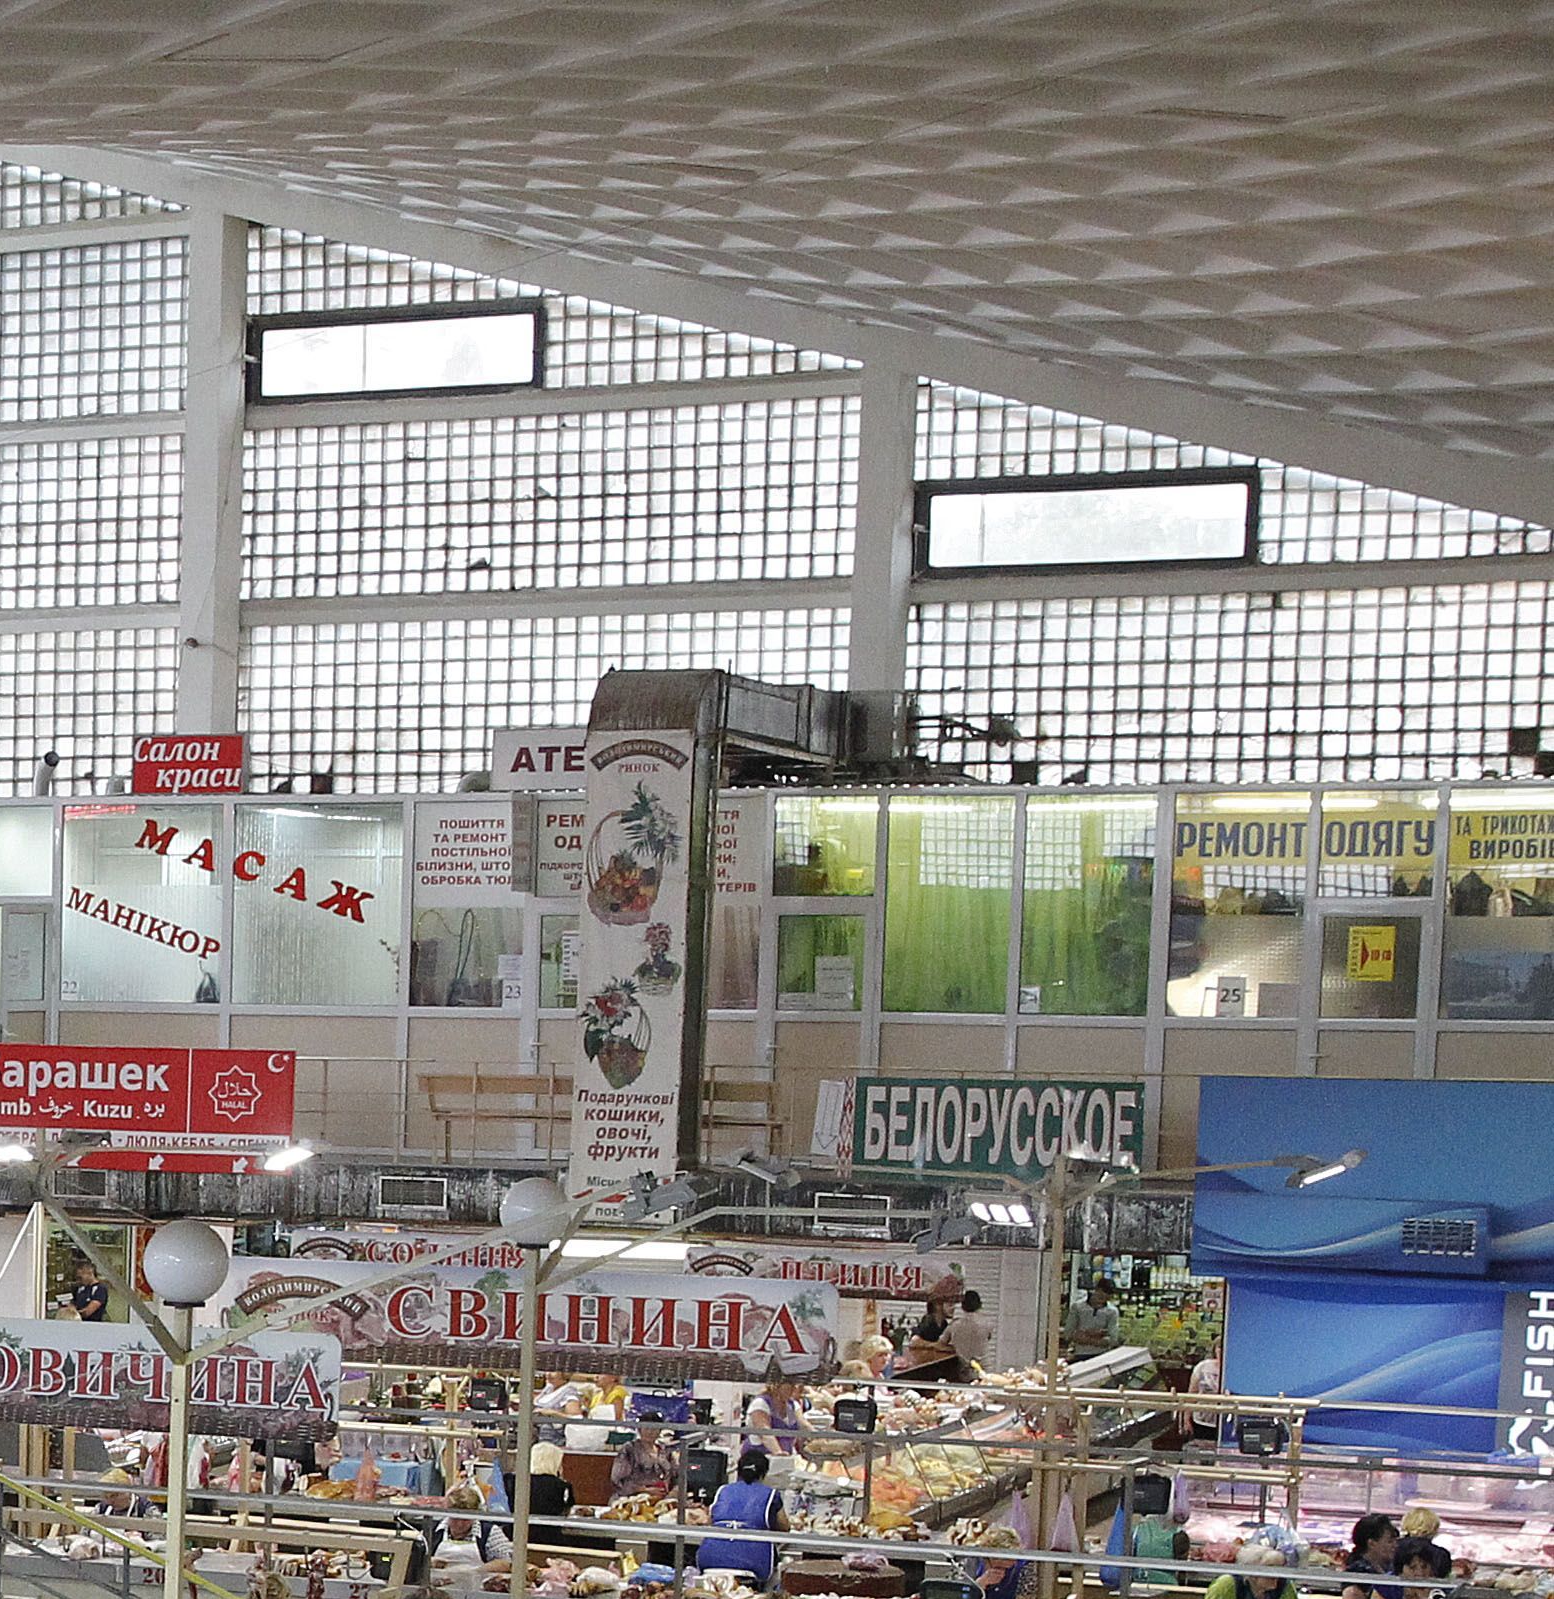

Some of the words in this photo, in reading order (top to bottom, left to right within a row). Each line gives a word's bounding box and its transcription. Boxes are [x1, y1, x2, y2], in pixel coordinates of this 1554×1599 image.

[134, 736, 220, 764] Салон
[510, 746, 585, 773] АТЕ
[618, 762, 660, 774] РИНОК
[156, 764, 242, 792] краси
[439, 819, 505, 830] ПОШИТТЯ
[546, 814, 584, 828] РЕМ
[1455, 815, 1471, 836] ТА
[433, 832, 451, 843] ТА
[454, 832, 507, 843] РЕМОНТ
[1176, 821, 1308, 857] РЕМОНТ
[1324, 820, 1435, 857] ОДЯГУ
[134, 819, 375, 924] МАСАЖ
[481, 860, 511, 872] ШТО
[421, 874, 482, 886] ОБРОБКА
[65, 886, 221, 961] МАНІКЮР
[61, 980, 77, 994] 22
[505, 985, 522, 1000] 23
[1220, 988, 1241, 1002] 25
[217, 1081, 253, 1099] حلال
[577, 1089, 674, 1107] Подарункові
[38, 1096, 74, 1119] خروف
[83, 1100, 133, 1119] Kuzu
[221, 1101, 248, 1110] HALAL
[584, 1108, 665, 1126] кошики,
[595, 1123, 653, 1145] овочі,
[865, 1085, 1138, 1171] БЕЛОРУССКОЕ
[587, 1140, 661, 1162] фрукти
[780, 1258, 923, 1295] ПТИЦЯ
[388, 1282, 809, 1355] СВИНИНА
